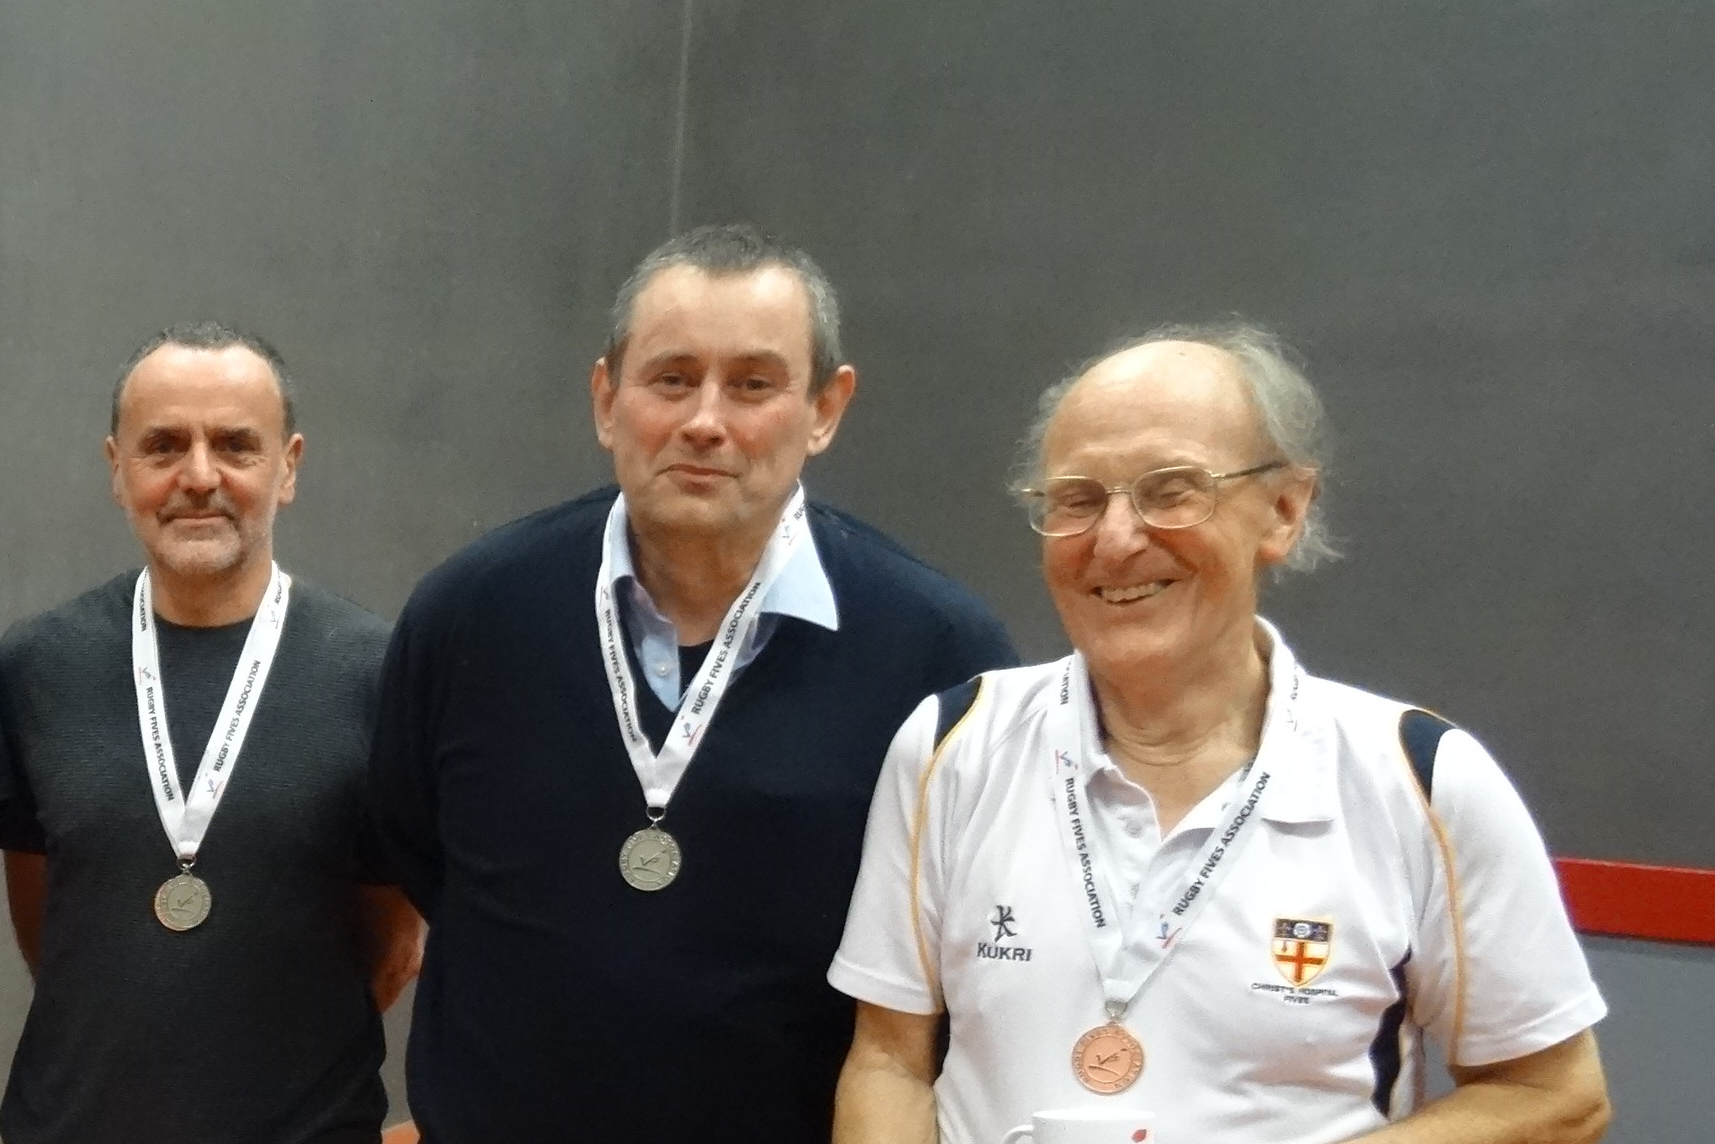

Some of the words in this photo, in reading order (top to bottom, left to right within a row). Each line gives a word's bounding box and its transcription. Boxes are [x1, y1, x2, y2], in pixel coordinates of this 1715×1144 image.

[605, 609, 614, 642] RUGBY
[691, 679, 714, 715] RUGBY
[709, 650, 728, 679] FIVES
[723, 582, 761, 649] ASSOCIATION
[146, 686, 155, 714] RUGBY
[213, 742, 230, 772] RUGBY
[225, 717, 239, 741] FIVES
[235, 659, 261, 716] ASSOCIATION
[150, 716, 160, 741] FIVES
[154, 743, 174, 801] ASSOCIATION
[1065, 777, 1079, 816] RUGBY
[1071, 818, 1086, 851] FIVES
[1172, 877, 1204, 916] RUGBY
[1199, 846, 1225, 879] FIVES
[1221, 772, 1271, 847] ASSOCIATION
[1079, 853, 1106, 928] ASSOCIATION
[976, 942, 1032, 961] KUKRI
